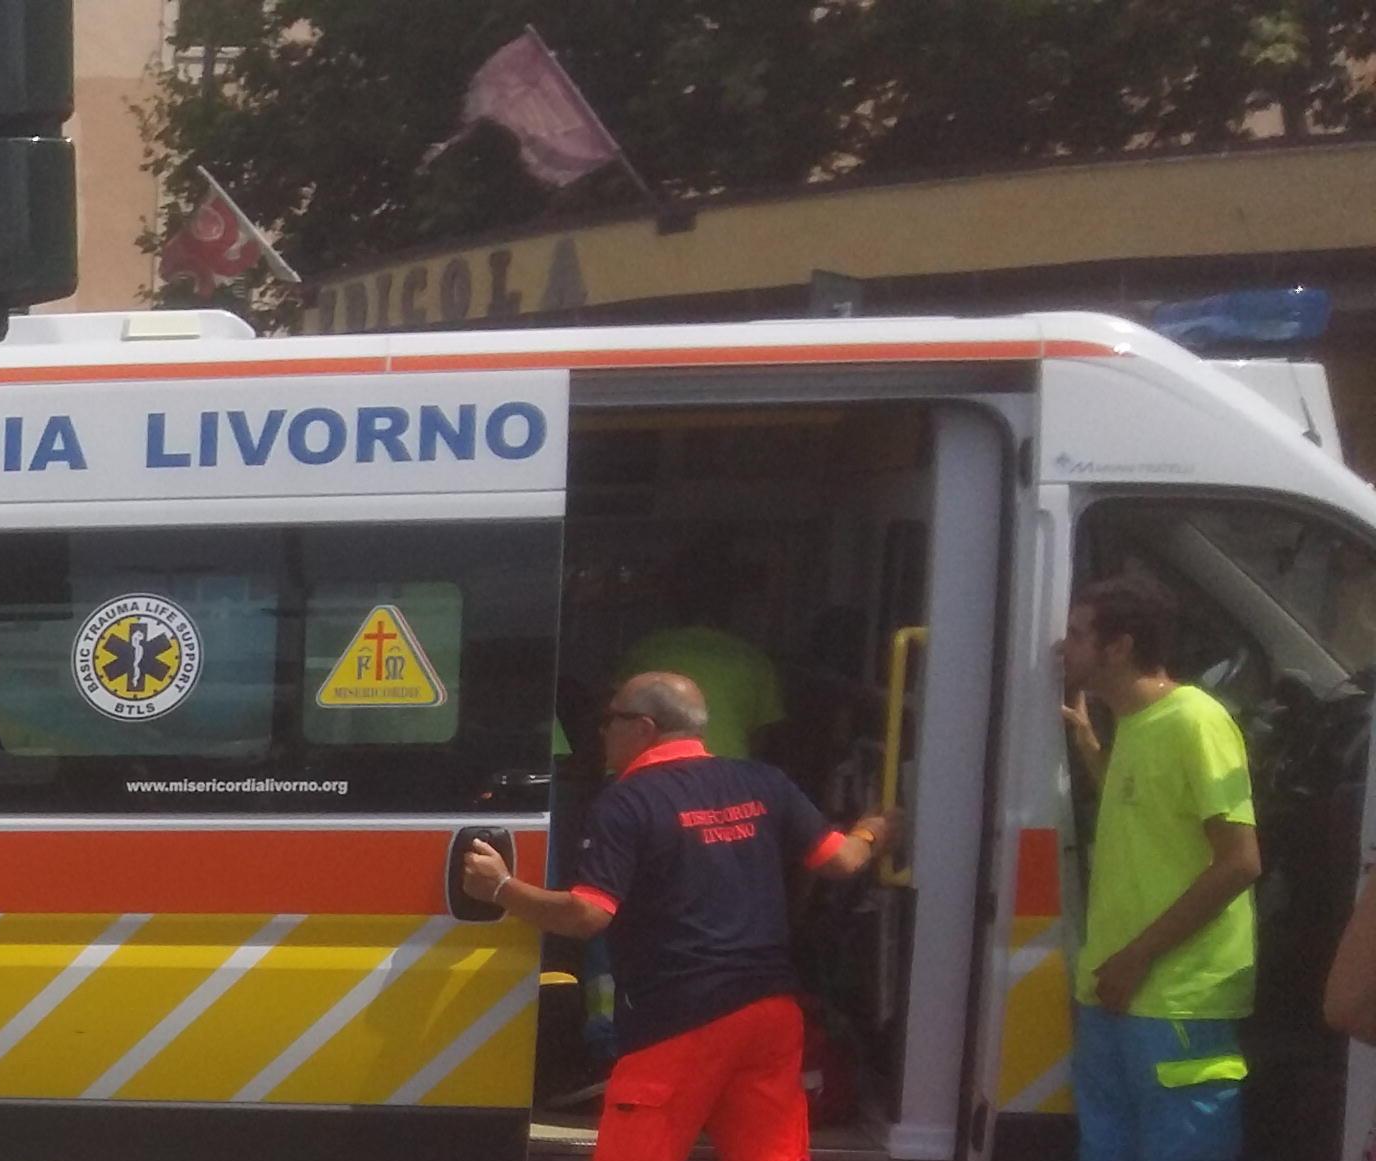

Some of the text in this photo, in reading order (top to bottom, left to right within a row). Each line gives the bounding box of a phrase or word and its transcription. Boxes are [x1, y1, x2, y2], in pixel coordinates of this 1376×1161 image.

[146, 401, 547, 468] LIVORNO
[79, 601, 196, 693] BASIC TRAUMA LIFE SUPPORT
[114, 702, 156, 715] BTLS
[126, 778, 348, 795] www.misericordialivorno.org
